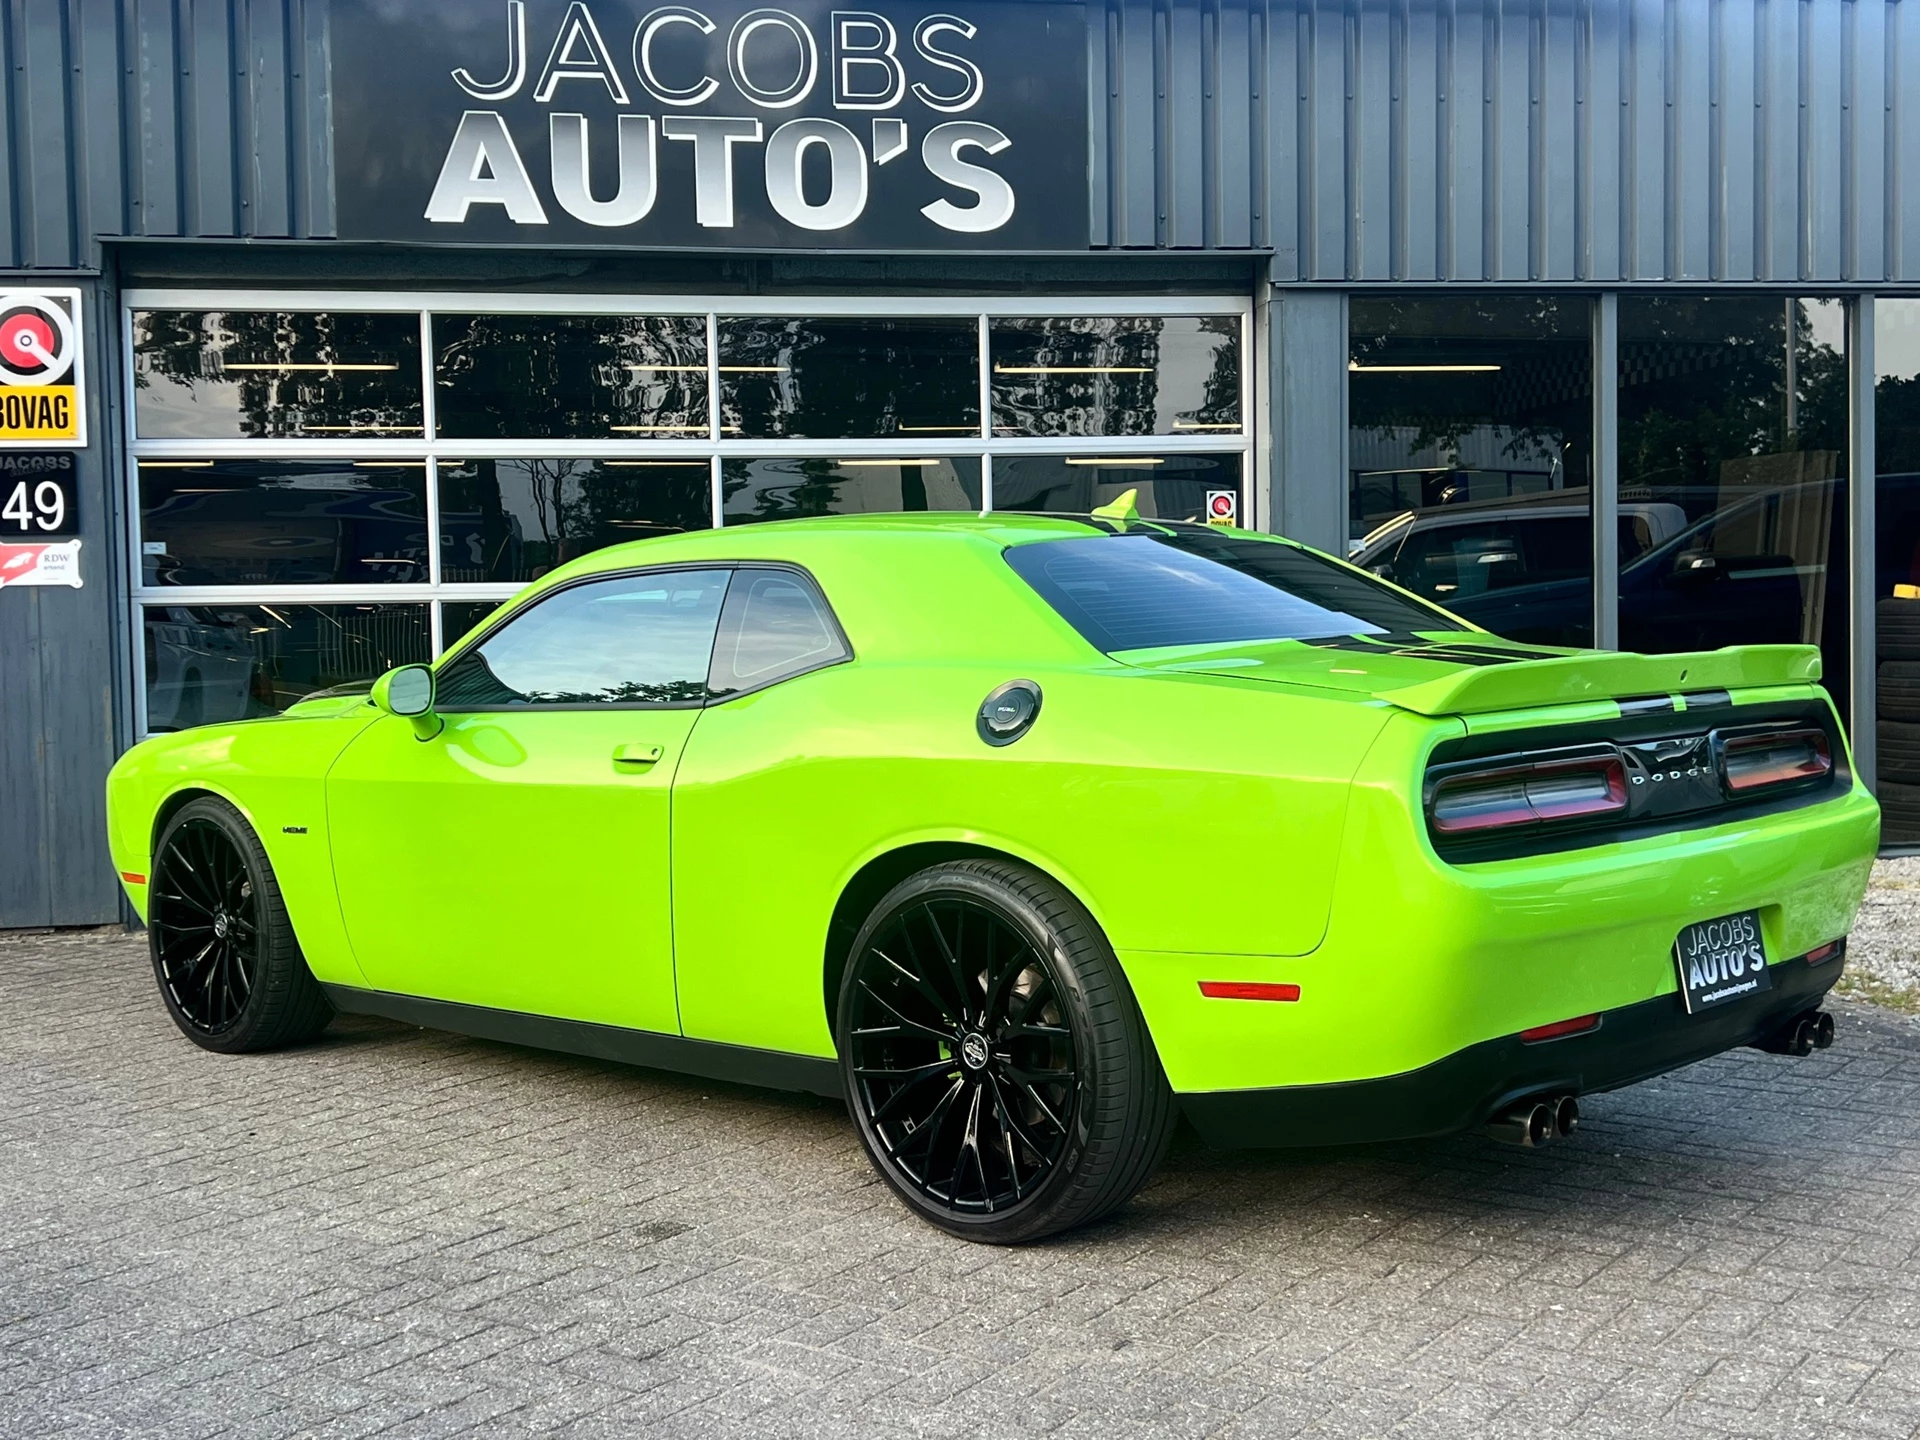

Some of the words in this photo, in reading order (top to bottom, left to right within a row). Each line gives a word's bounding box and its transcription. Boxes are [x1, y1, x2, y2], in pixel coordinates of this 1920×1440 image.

[450, 0, 984, 113] JACOBS
[424, 110, 1015, 232] AUTO'S
[2, 480, 64, 531] 49
[44, 554, 70, 562] RDW
[1631, 766, 1713, 785] DODGE
[1687, 915, 1755, 956] JACOBS
[1690, 941, 1764, 990] AUTO'S
